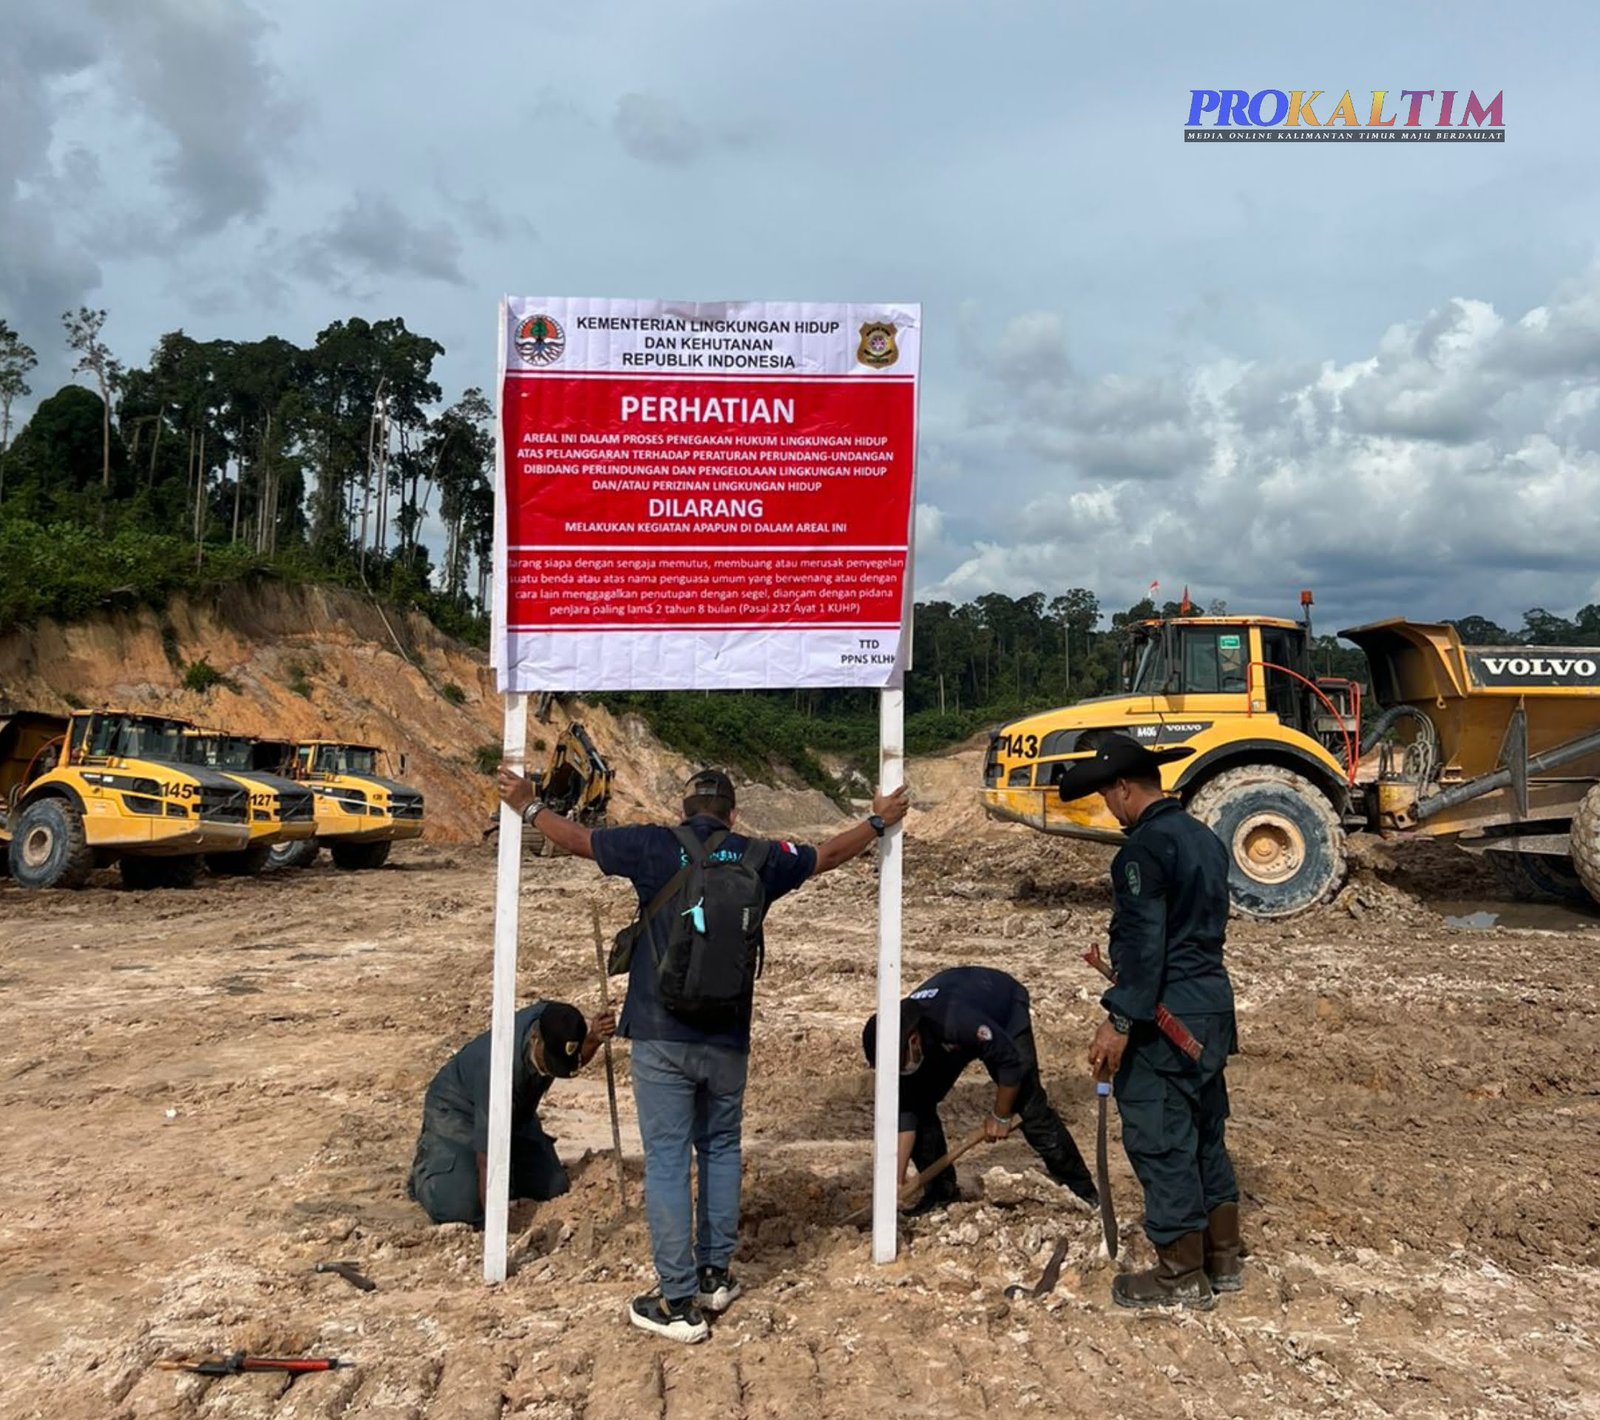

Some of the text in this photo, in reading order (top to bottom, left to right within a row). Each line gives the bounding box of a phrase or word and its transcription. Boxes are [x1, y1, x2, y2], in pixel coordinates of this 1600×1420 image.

[577, 316, 840, 334] KEMENTERIAN LINGKUNGAN HIDUP
[645, 337, 773, 351] DAN KEHUTANAN
[622, 353, 796, 368] REPUBLIK INDONESIA
[620, 396, 795, 424] PERHATIAN
[523, 433, 888, 446] AREAL INI DALAM PROSES PENEGAKAN HUKUM LINGKUNGAN HIDUP
[517, 448, 894, 462] ATAS PELANGGARAN TERHADAP PERATURAN PERUNDANG-UNDANGAN
[524, 464, 887, 476] DIBIDANG PERLINDUNGAN DAN PENGELOLAAN LINGKUNGAN HIDUP
[592, 480, 822, 492] DAN/ATAU PERIZINAN LINGKUNGAN HIDUP
[649, 498, 764, 518] DILARANG
[564, 522, 847, 533] MELAKUKAN KEGIATAN APAPUN DI DALAM AREAL INI
[544, 558, 572, 570] siapa
[574, 558, 614, 570] dengan
[616, 559, 656, 570] sengaja
[658, 559, 711, 570] memutus,
[714, 558, 772, 570] membuang
[775, 559, 798, 568] atau
[800, 558, 844, 568] merusak
[846, 558, 904, 570] penyegelan
[540, 573, 574, 584] benda
[576, 574, 600, 584] atau
[602, 574, 625, 584] atas
[628, 576, 657, 584] nama
[660, 576, 709, 586] penguasa
[712, 576, 746, 584] umum
[748, 575, 772, 585] yang
[775, 573, 832, 585] berwenang
[834, 574, 858, 583] atau
[860, 573, 896, 584] dengan
[515, 588, 894, 601] cara lain menggagalkan penutupan dengan segel, diancam dengan pidana
[550, 602, 860, 616] penjara paling lama 2 tahun 8 bulan (Pasal 232 Ayat 1 KUHP)
[859, 640, 880, 650] TTD
[841, 654, 868, 664] PPNS
[1480, 658, 1597, 676] VOLVO
[1166, 724, 1202, 732] VOLVO
[1006, 734, 1038, 759] 143
[162, 782, 194, 800] 145
[250, 794, 272, 806] 127
